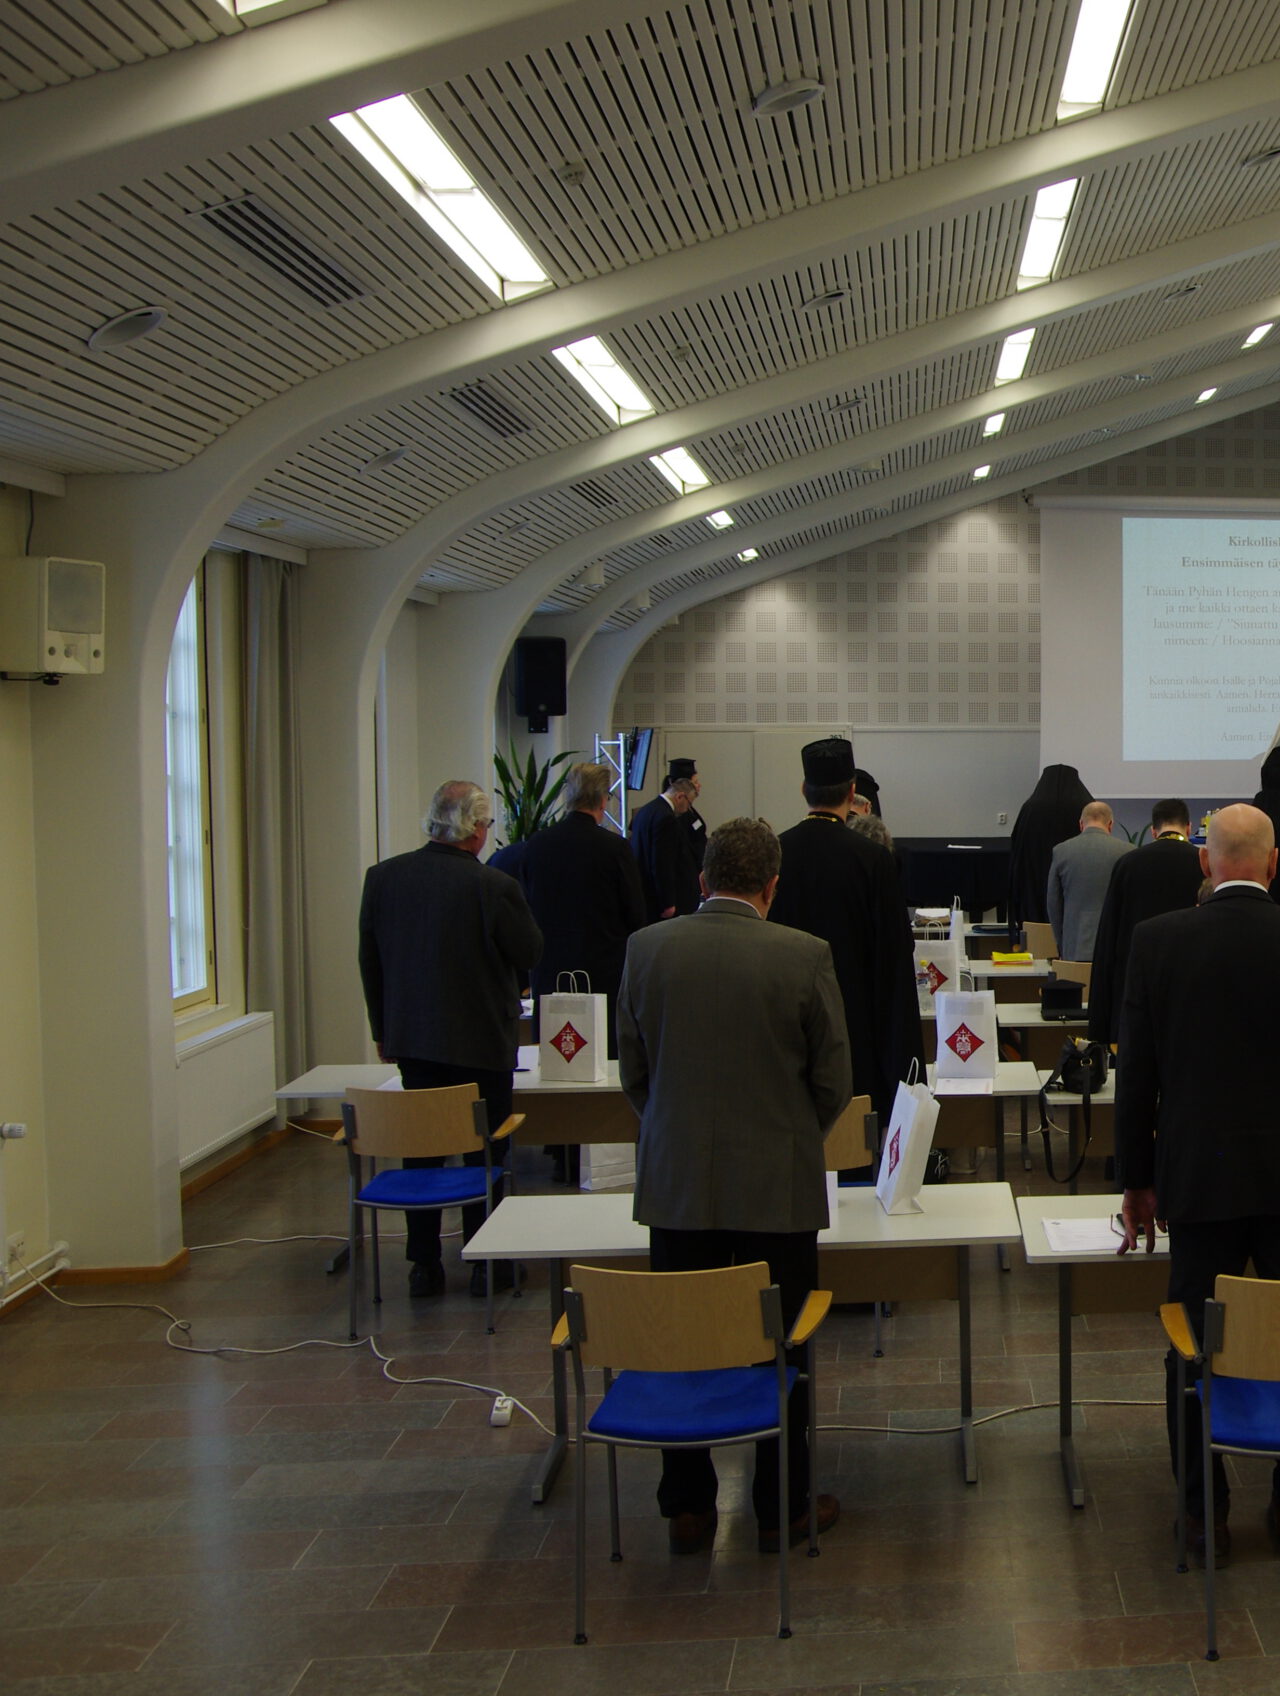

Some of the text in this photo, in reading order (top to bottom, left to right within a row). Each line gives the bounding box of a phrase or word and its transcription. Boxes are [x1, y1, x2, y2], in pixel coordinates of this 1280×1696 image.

[1182, 556, 1263, 568] Ensimmäisen
[1188, 585, 1222, 600] Pyhän
[1226, 586, 1269, 599] Hengen
[1165, 602, 1175, 615] ja
[1178, 605, 1196, 613] me
[1199, 602, 1232, 613] kaikki
[1234, 603, 1268, 613] ottaen
[1222, 635, 1280, 646] Hoosianna
